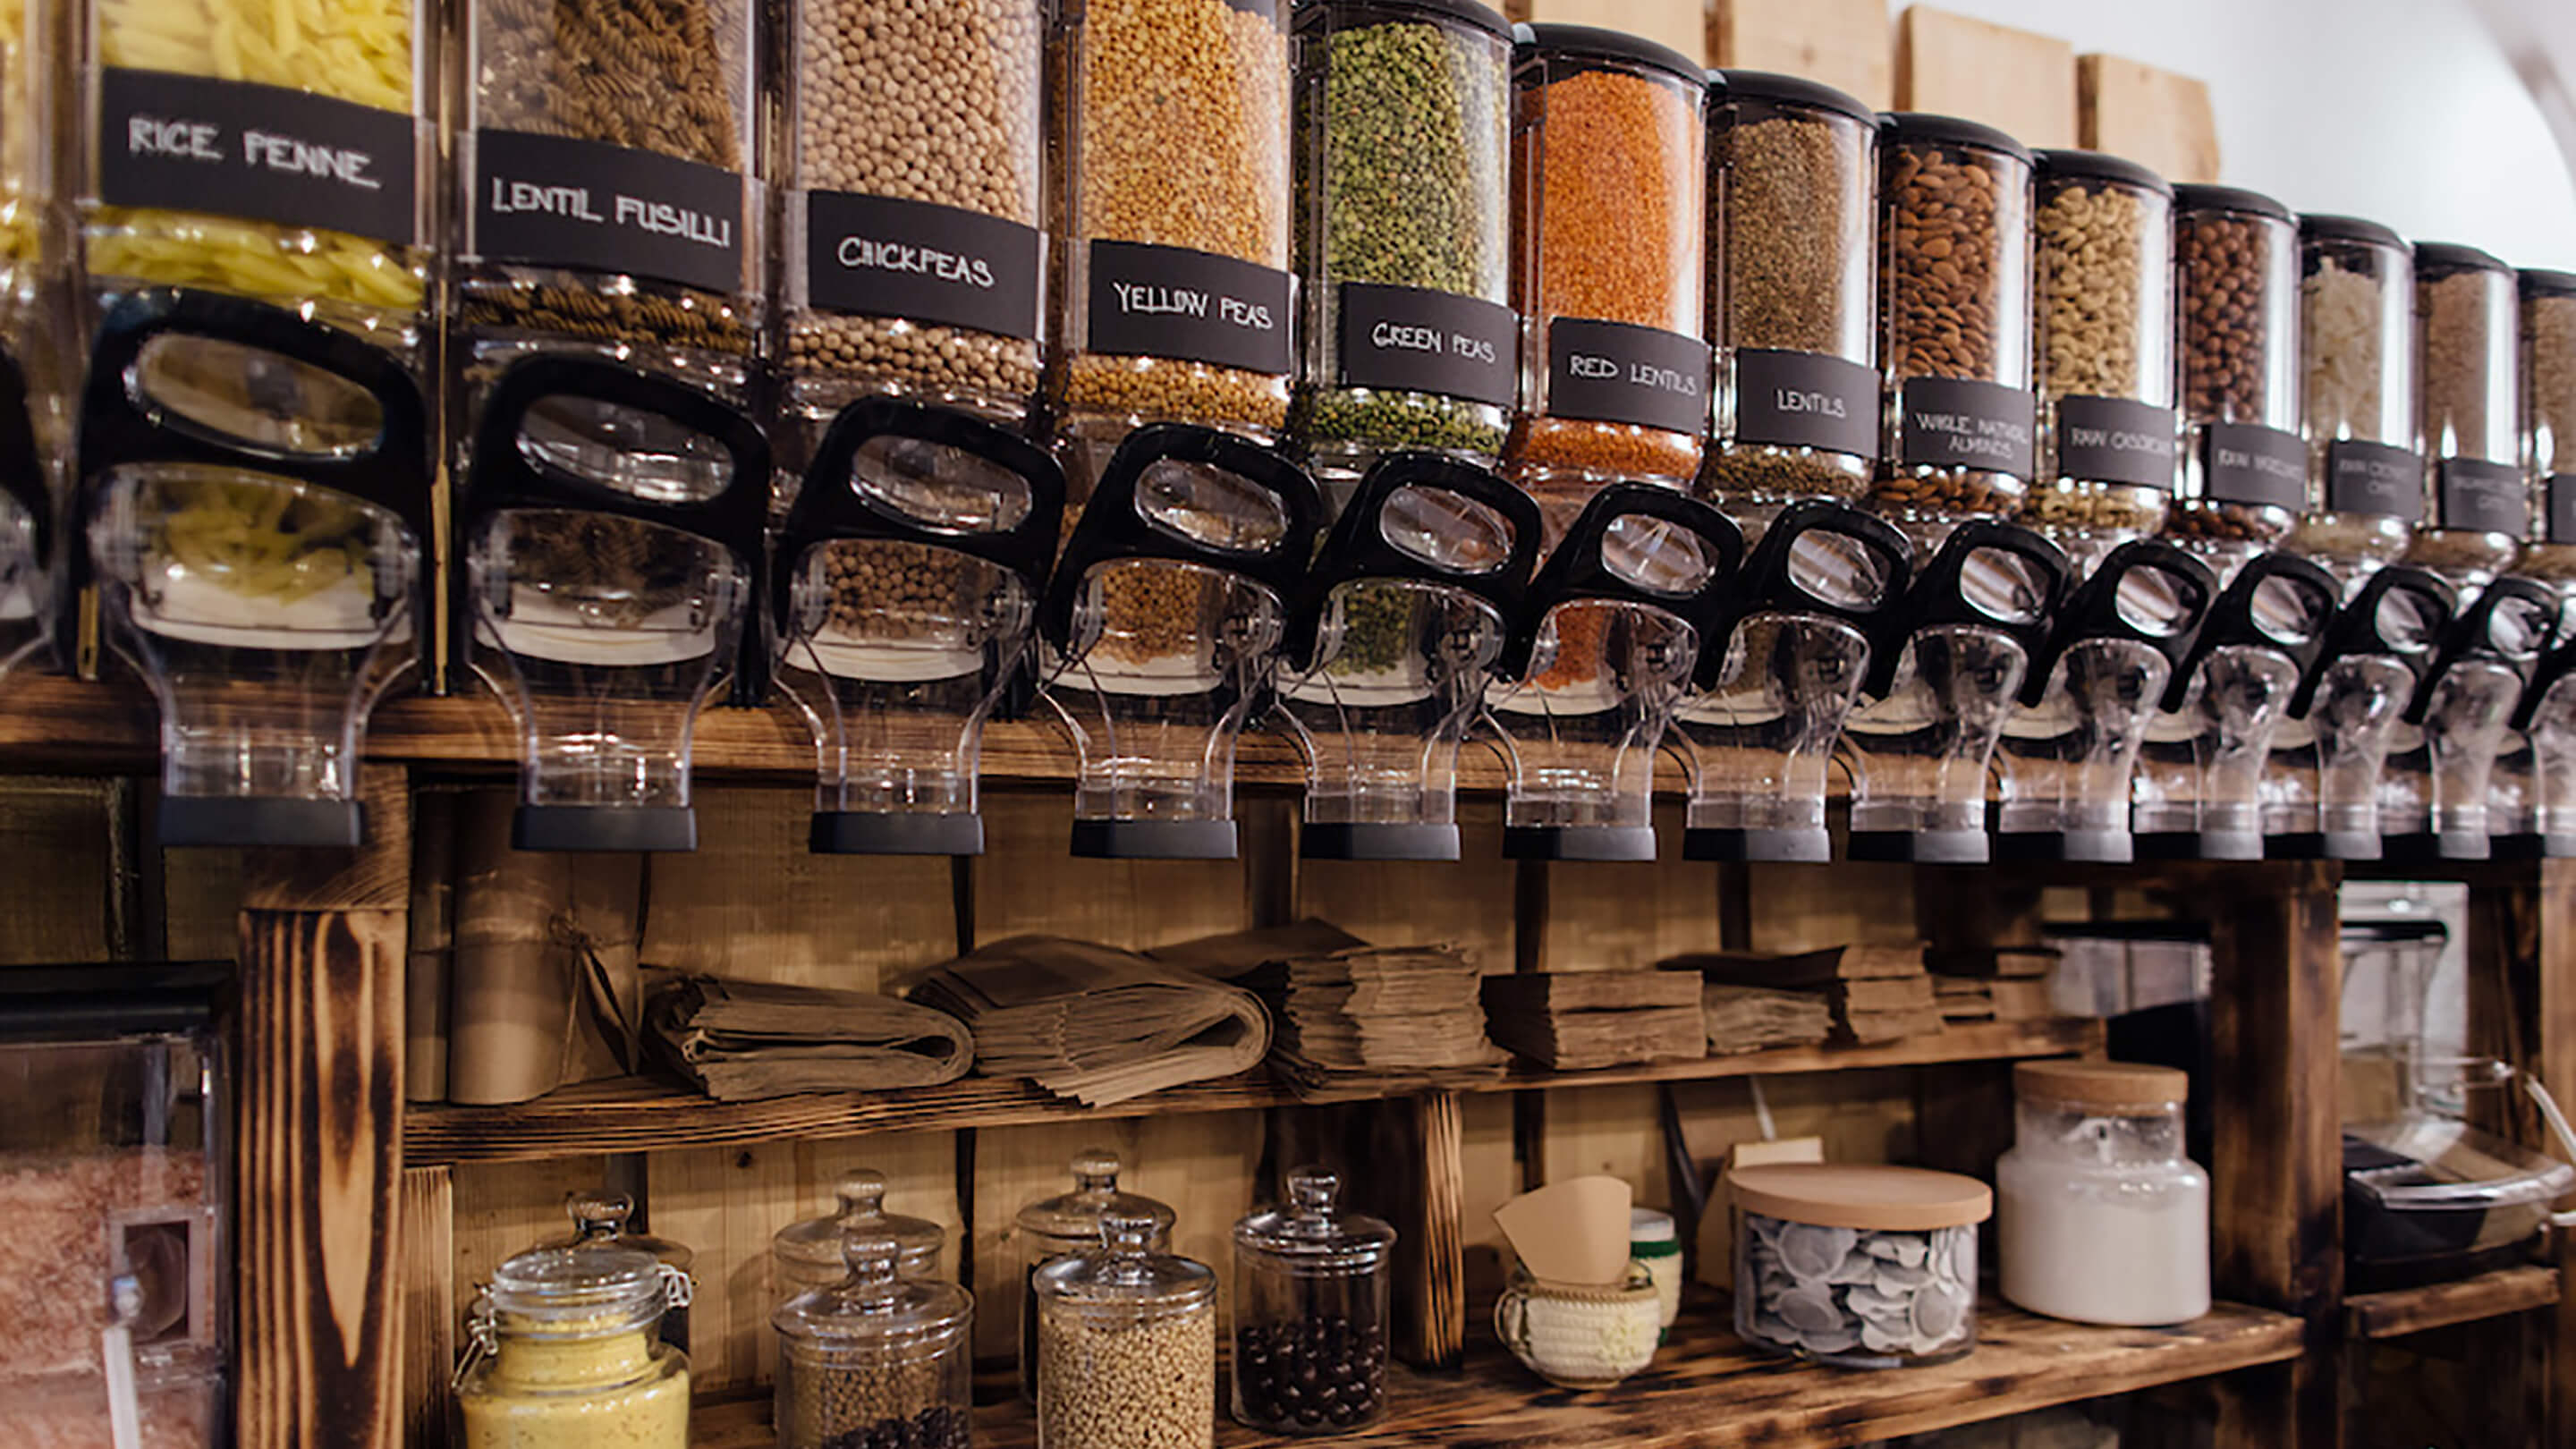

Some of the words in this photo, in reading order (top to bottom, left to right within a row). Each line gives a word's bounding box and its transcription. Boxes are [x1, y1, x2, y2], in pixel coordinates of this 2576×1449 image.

[129, 118, 225, 161] RICE
[243, 131, 382, 189] PENNE
[491, 176, 605, 224] LENTIL
[615, 194, 731, 248] FUSILLI
[837, 236, 995, 288] CHICKPEAS
[1113, 282, 1209, 318] YELLOW
[1220, 297, 1274, 330] PEAS
[1371, 322, 1442, 353] GREEN
[1452, 334, 1496, 364] PEAS
[1570, 354, 1620, 378] RED
[1629, 362, 1697, 396] LENTILS
[1776, 388, 1846, 419] LENTILS
